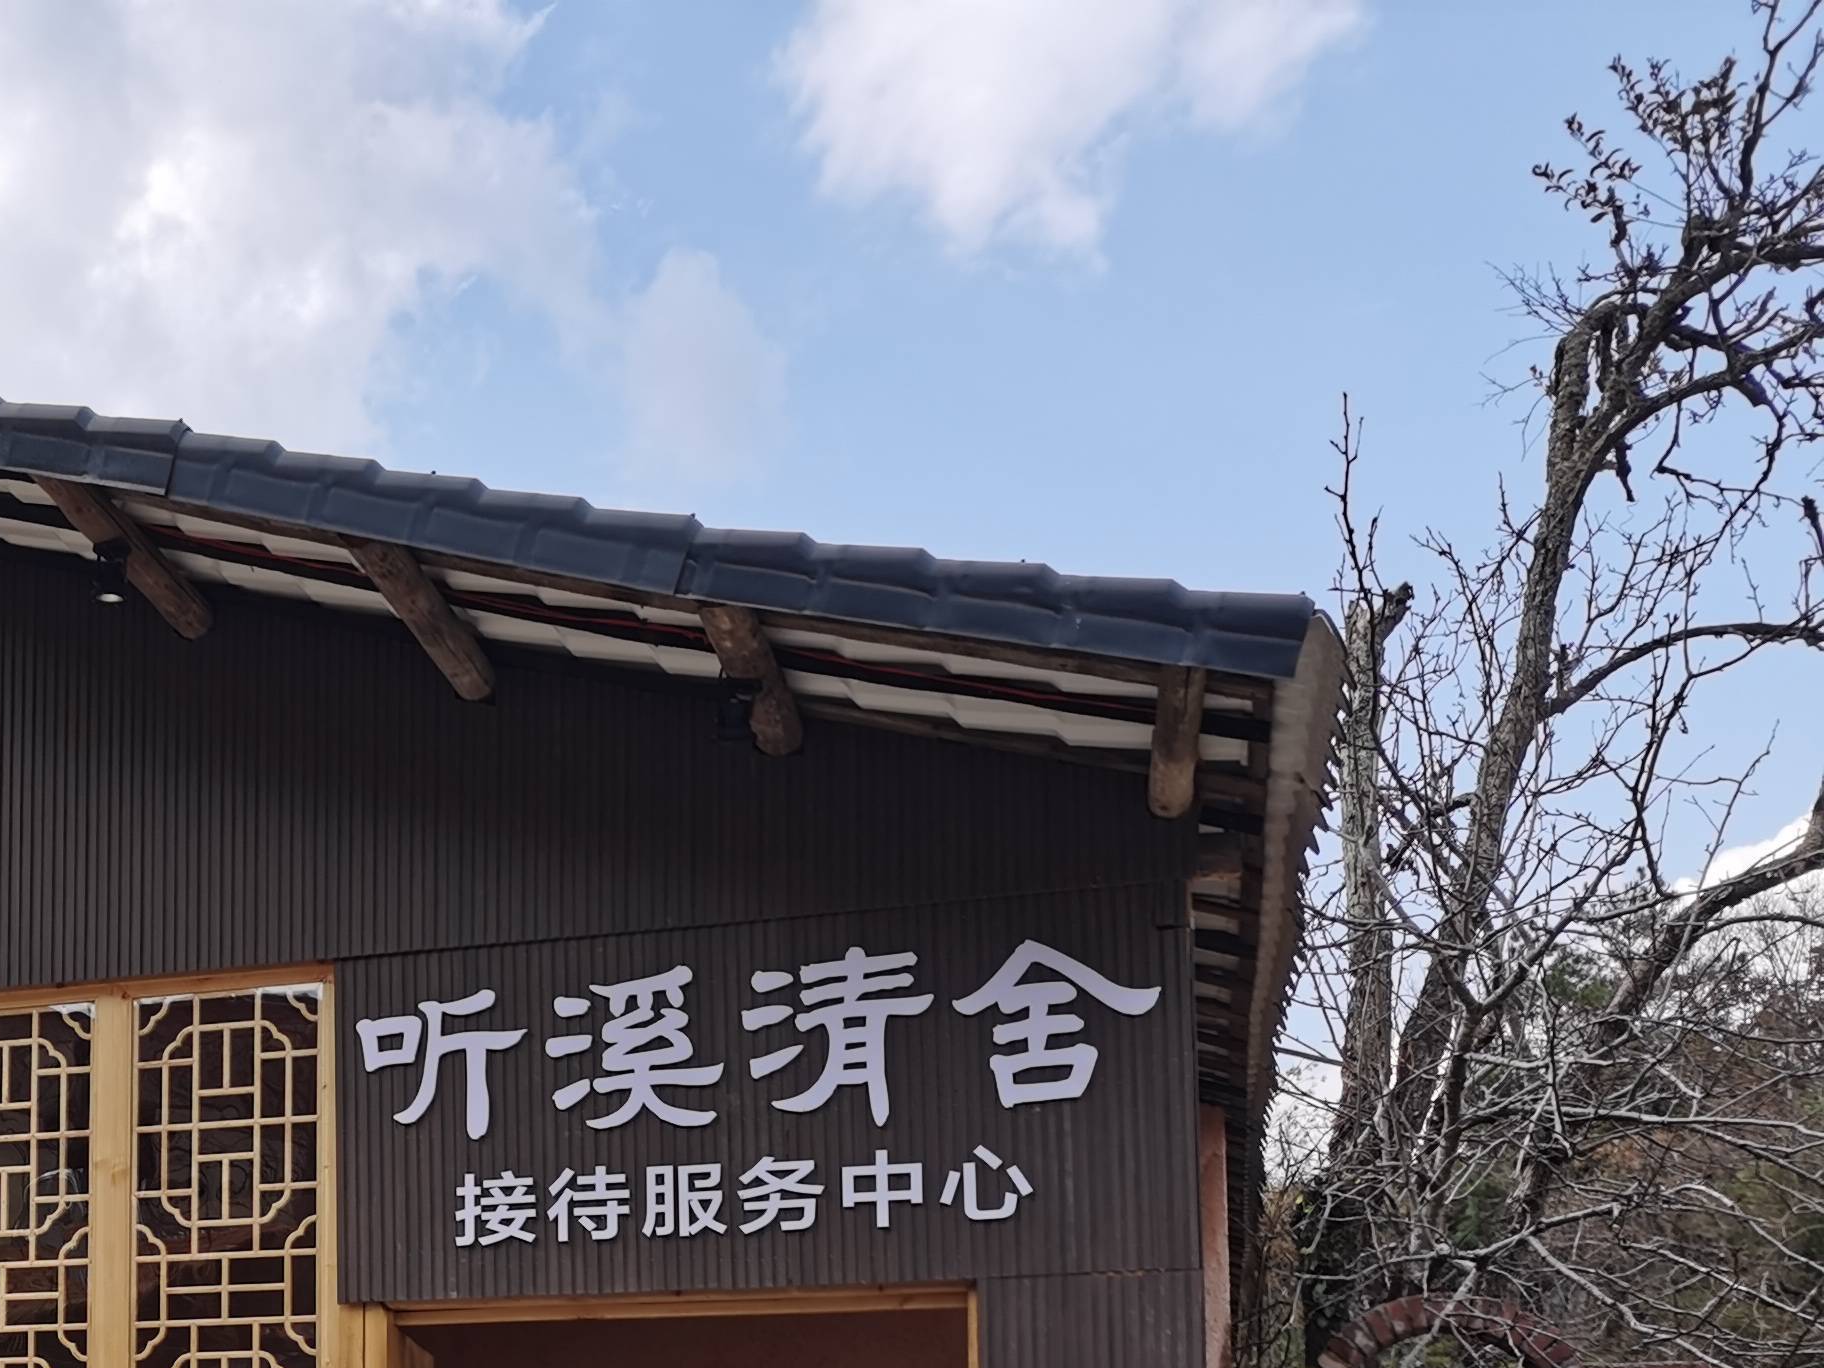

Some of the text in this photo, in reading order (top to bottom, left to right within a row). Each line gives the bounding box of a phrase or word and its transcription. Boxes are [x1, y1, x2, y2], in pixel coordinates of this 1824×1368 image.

[355, 939, 1163, 1141] 听溪清舍
[453, 1144, 1036, 1248] 接待服务中心
